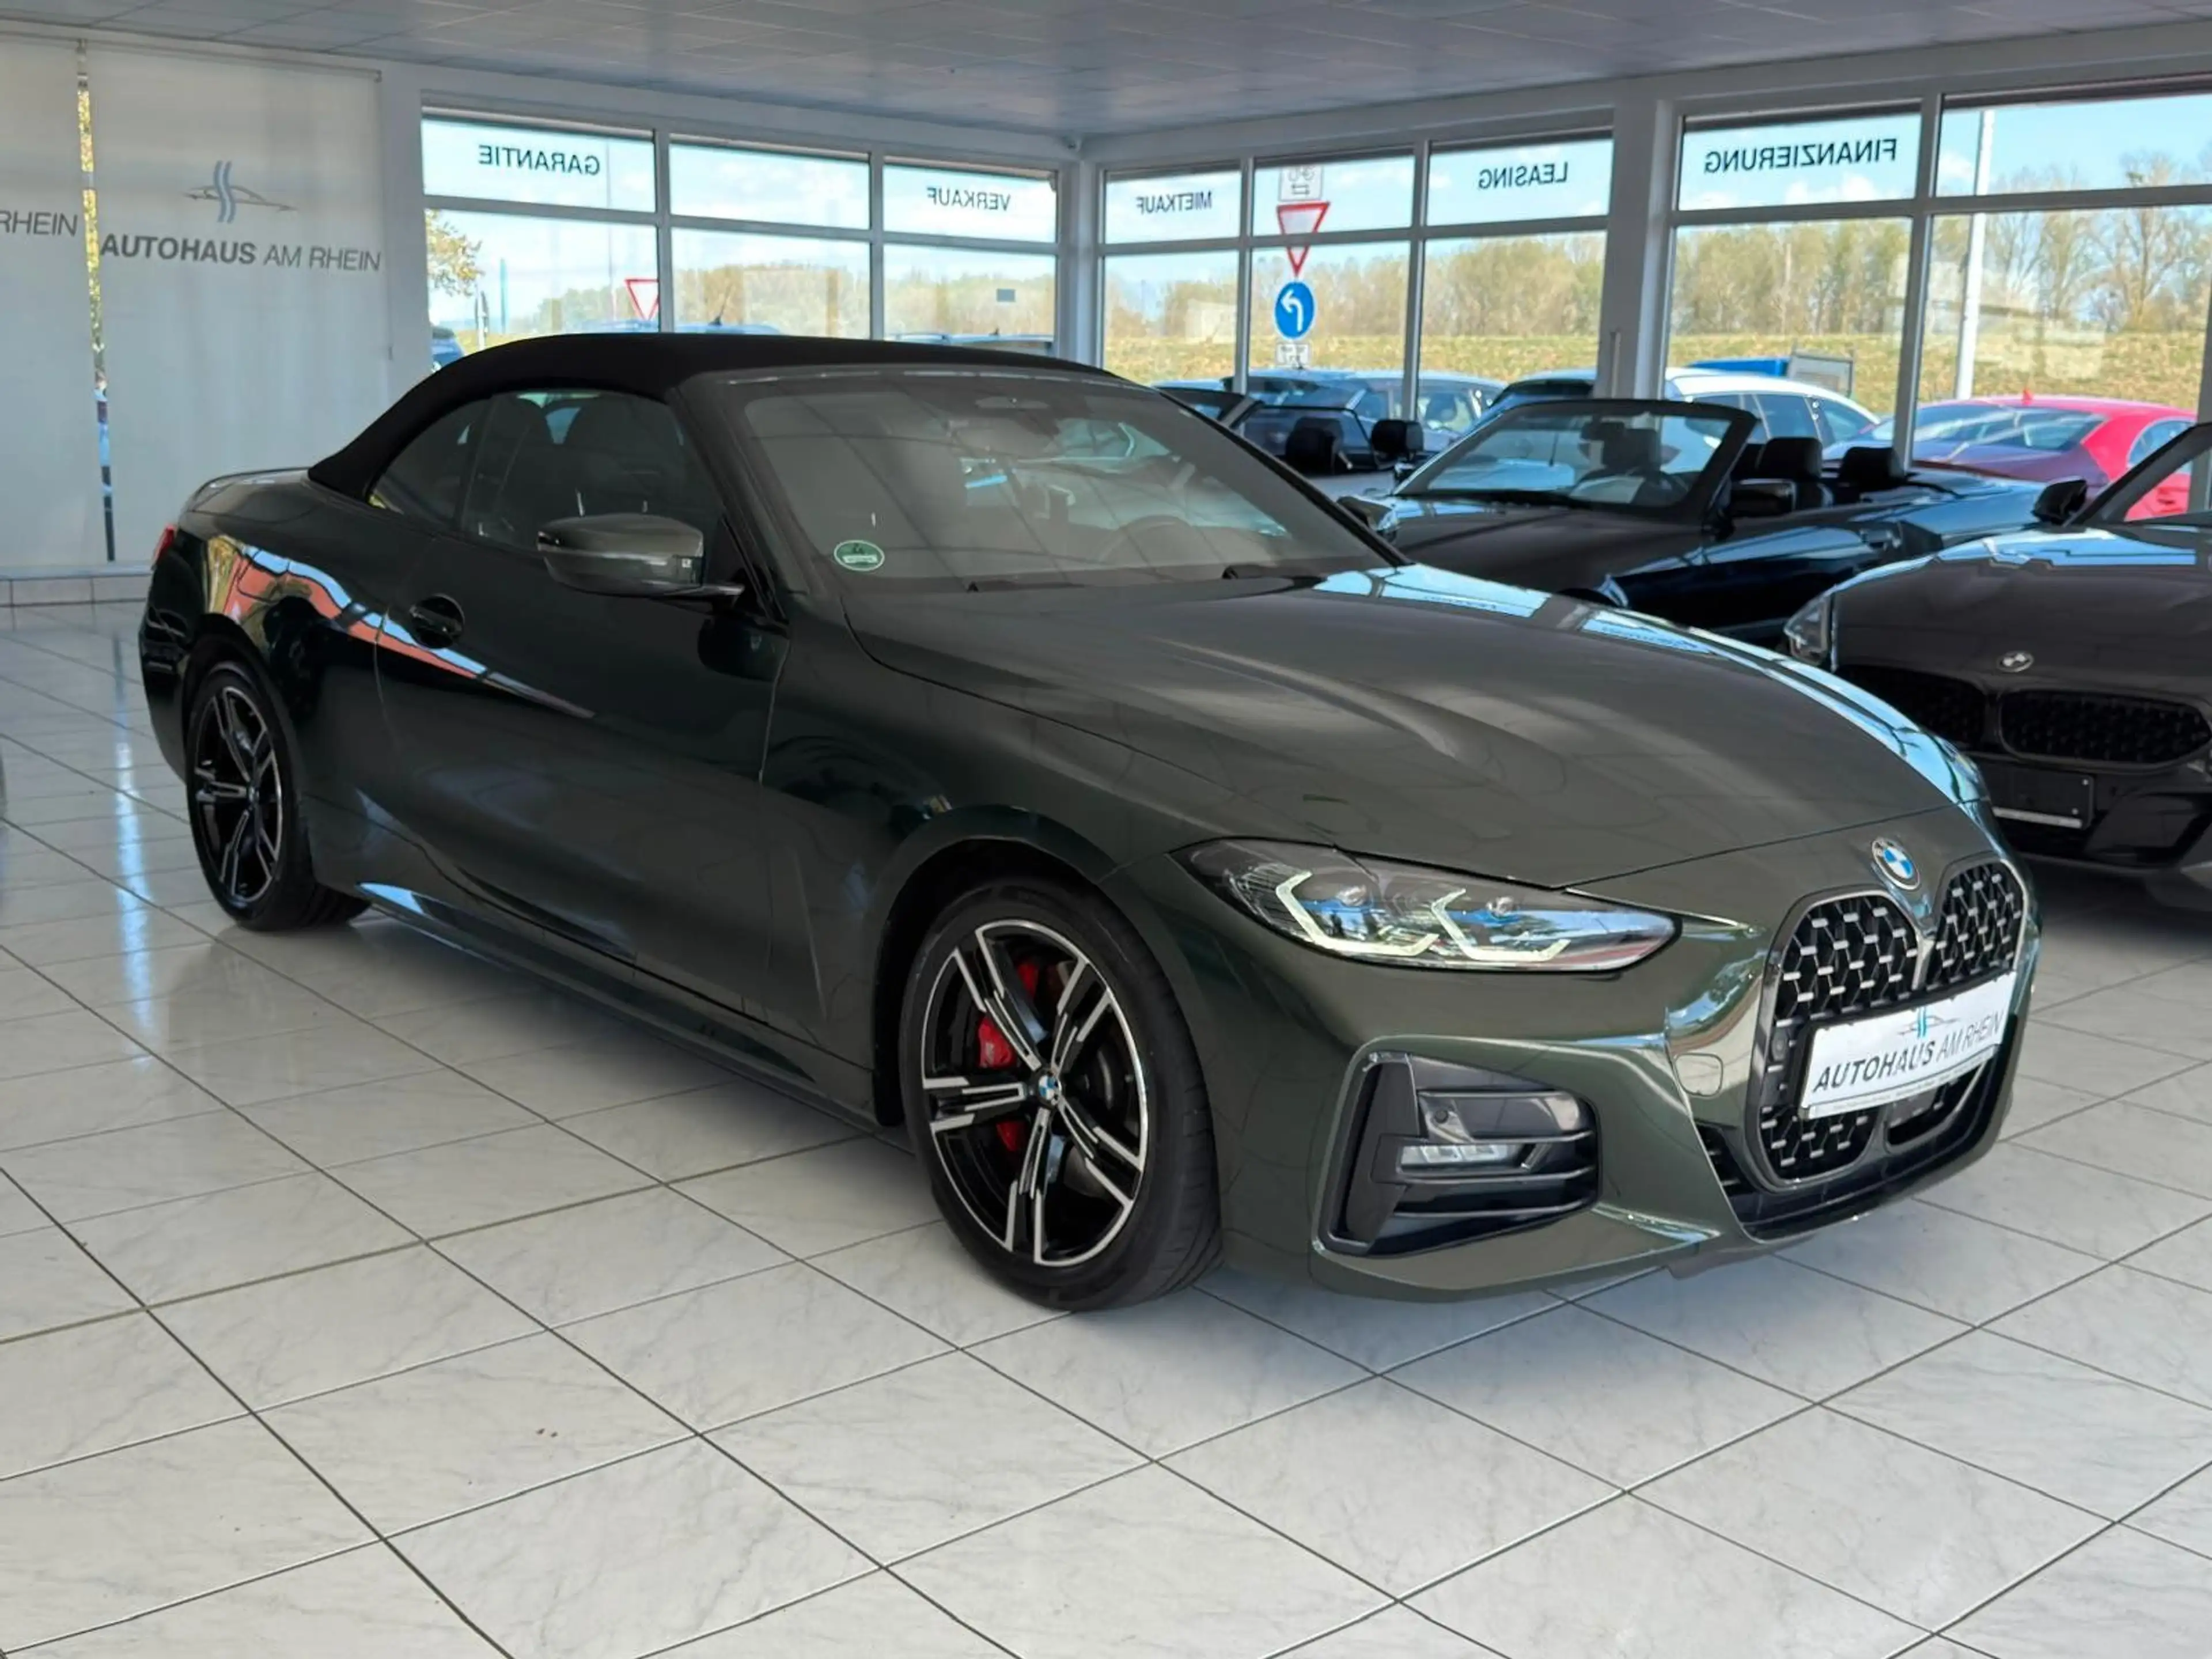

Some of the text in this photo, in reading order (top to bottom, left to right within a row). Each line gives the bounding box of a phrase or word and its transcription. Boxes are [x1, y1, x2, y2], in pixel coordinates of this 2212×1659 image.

[100, 233, 381, 272] AUTOHAUS AM RHEIN
[1813, 1040, 1936, 1093] AUTOHAUS
[1936, 1028, 1963, 1063] AM
